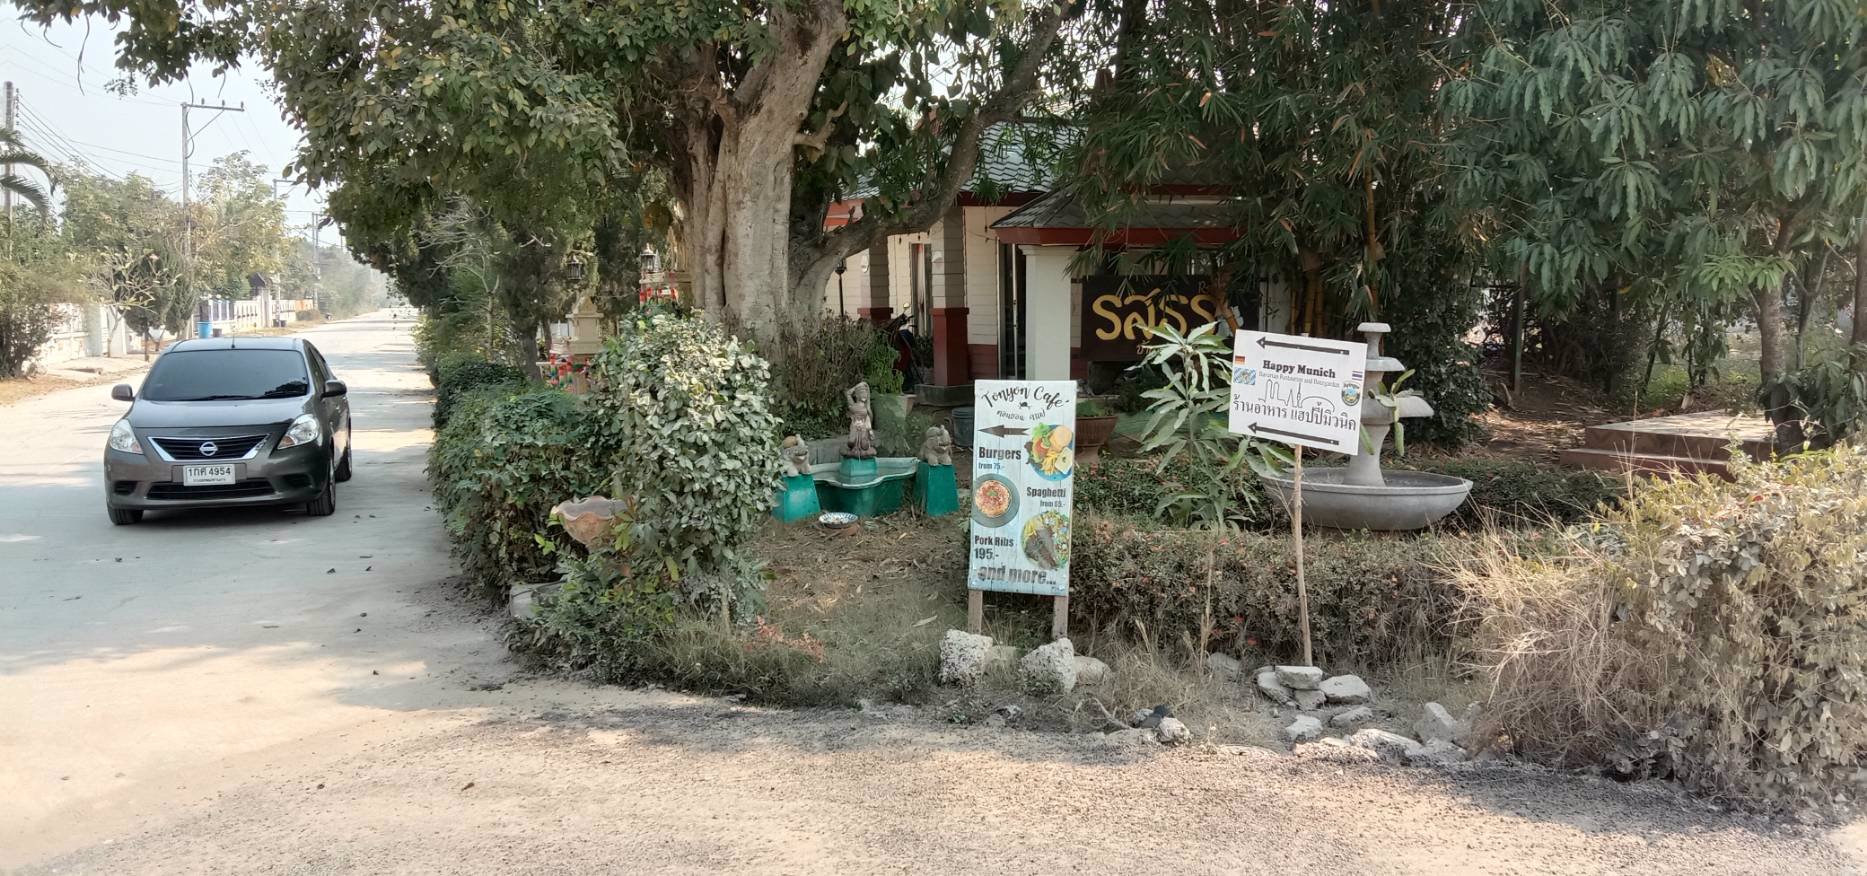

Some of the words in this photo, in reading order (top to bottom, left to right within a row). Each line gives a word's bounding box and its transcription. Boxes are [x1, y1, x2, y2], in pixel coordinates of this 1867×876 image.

[1262, 360, 1295, 374] Happy
[1297, 364, 1336, 379] Munich
[981, 385, 1031, 408] Tonyon
[1233, 393, 1287, 418] ร้านอาหาร
[978, 446, 1022, 460] Burgers
[208, 466, 231, 476] 4954
[978, 462, 993, 470] from
[1026, 486, 1067, 498] Spaghetti
[1040, 499, 1053, 507] from
[974, 535, 993, 546] Pork
[994, 536, 1014, 547] Ribs
[977, 564, 1006, 581] and
